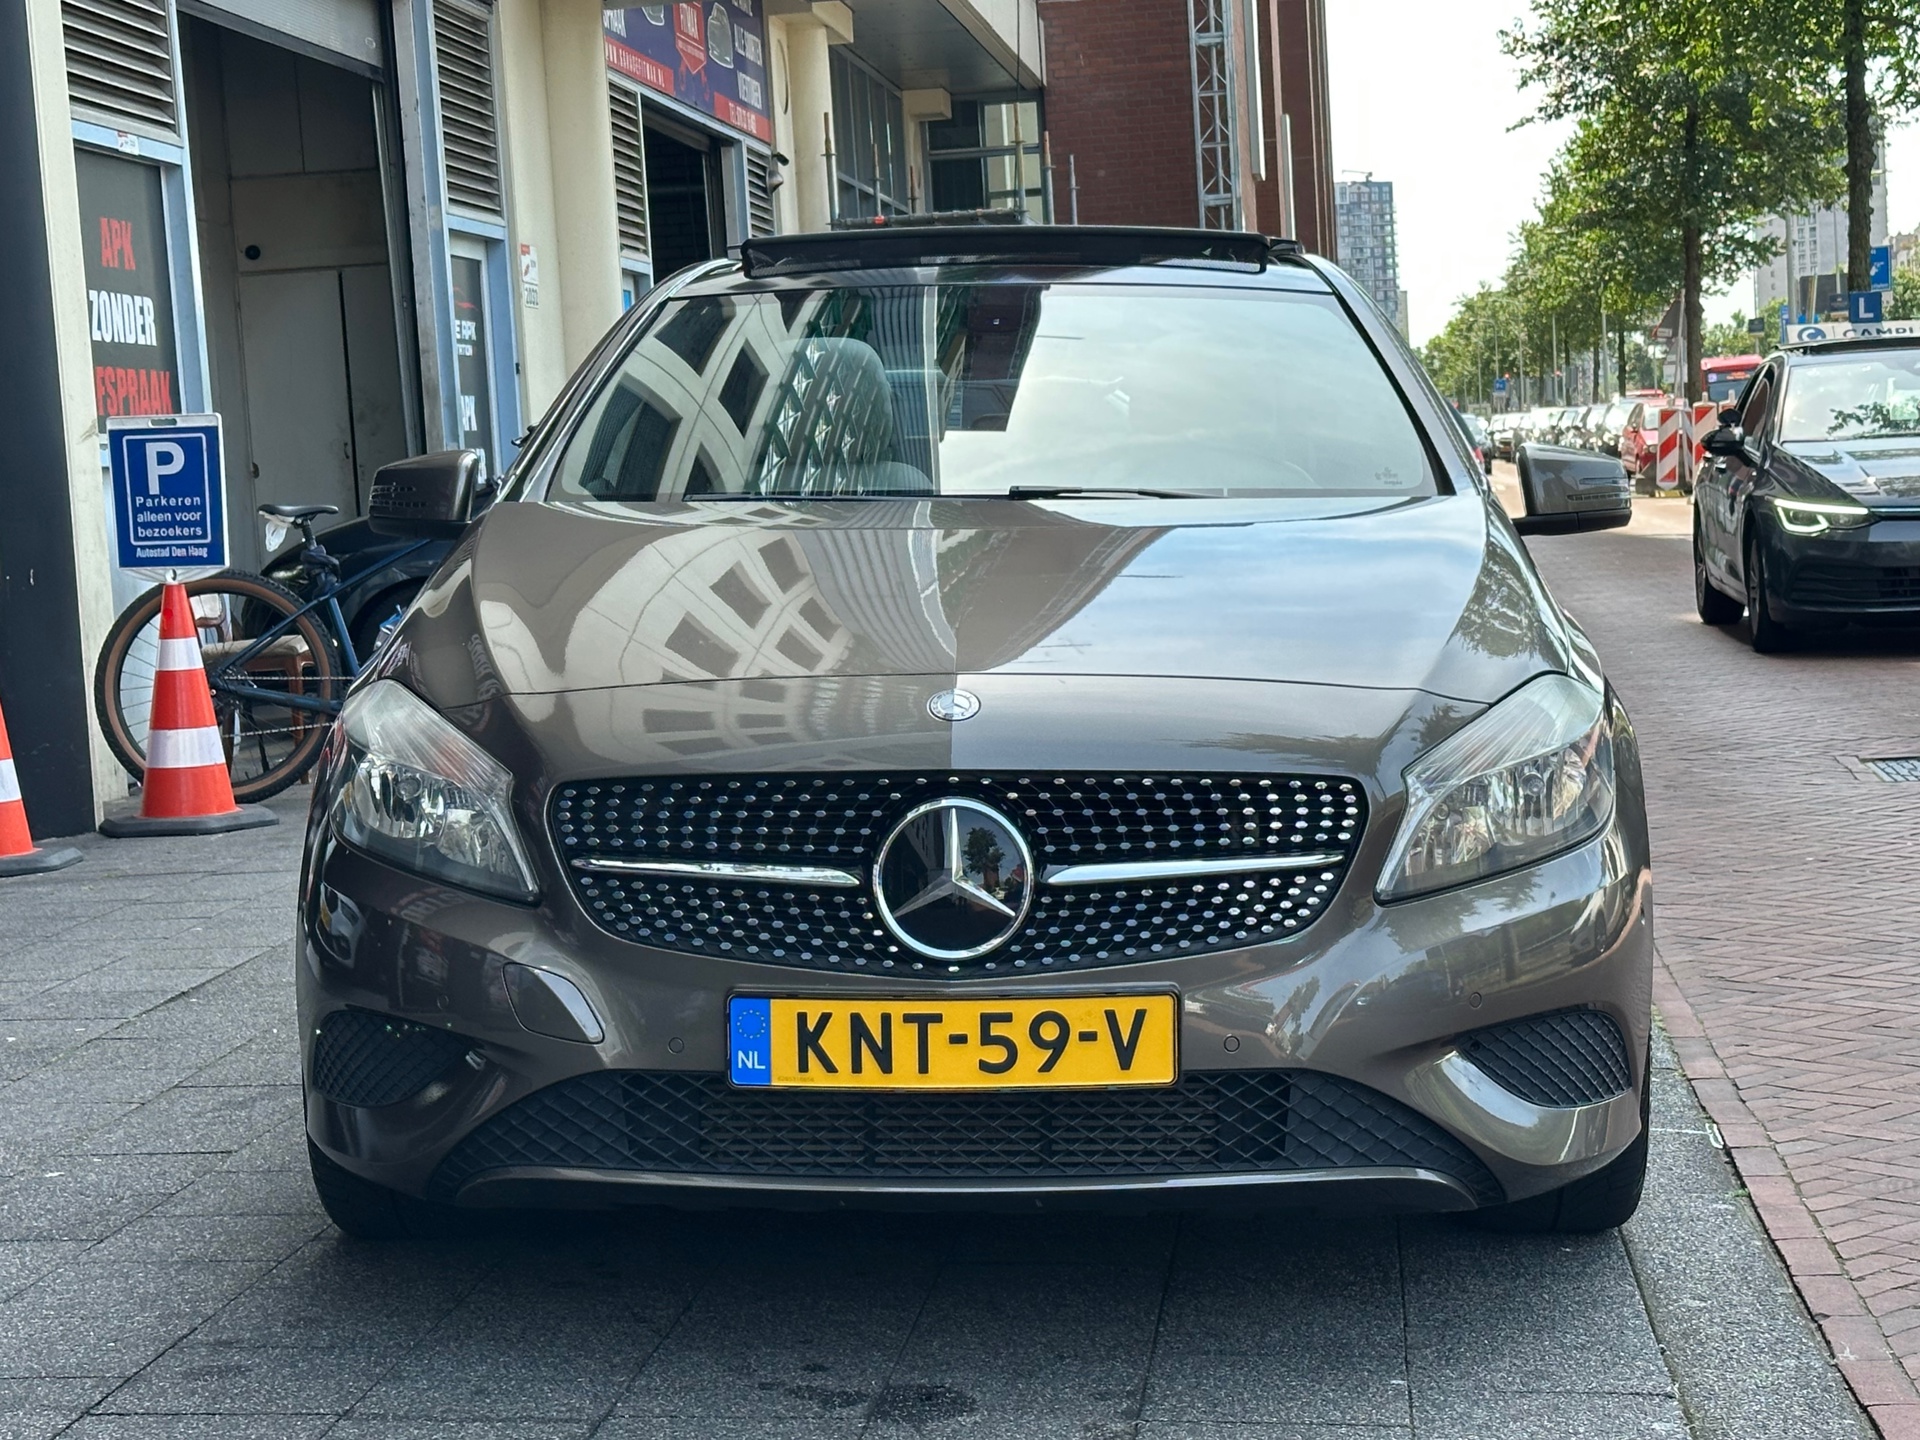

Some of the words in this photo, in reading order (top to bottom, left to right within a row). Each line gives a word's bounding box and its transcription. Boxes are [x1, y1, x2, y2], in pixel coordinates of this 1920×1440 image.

[100, 216, 136, 271] APK
[89, 289, 157, 346] ZONDER
[1858, 297, 1874, 319] L
[145, 442, 186, 495] P
[136, 495, 201, 508] Parkeren
[136, 511, 171, 522] alleen
[175, 511, 202, 522] voor
[138, 526, 203, 538] bezoekers
[136, 546, 170, 558] Autostad
[172, 546, 187, 557] Den
[188, 546, 208, 558] Haag
[737, 1049, 766, 1069] NL
[796, 1008, 1147, 1075] KNT-59-V
